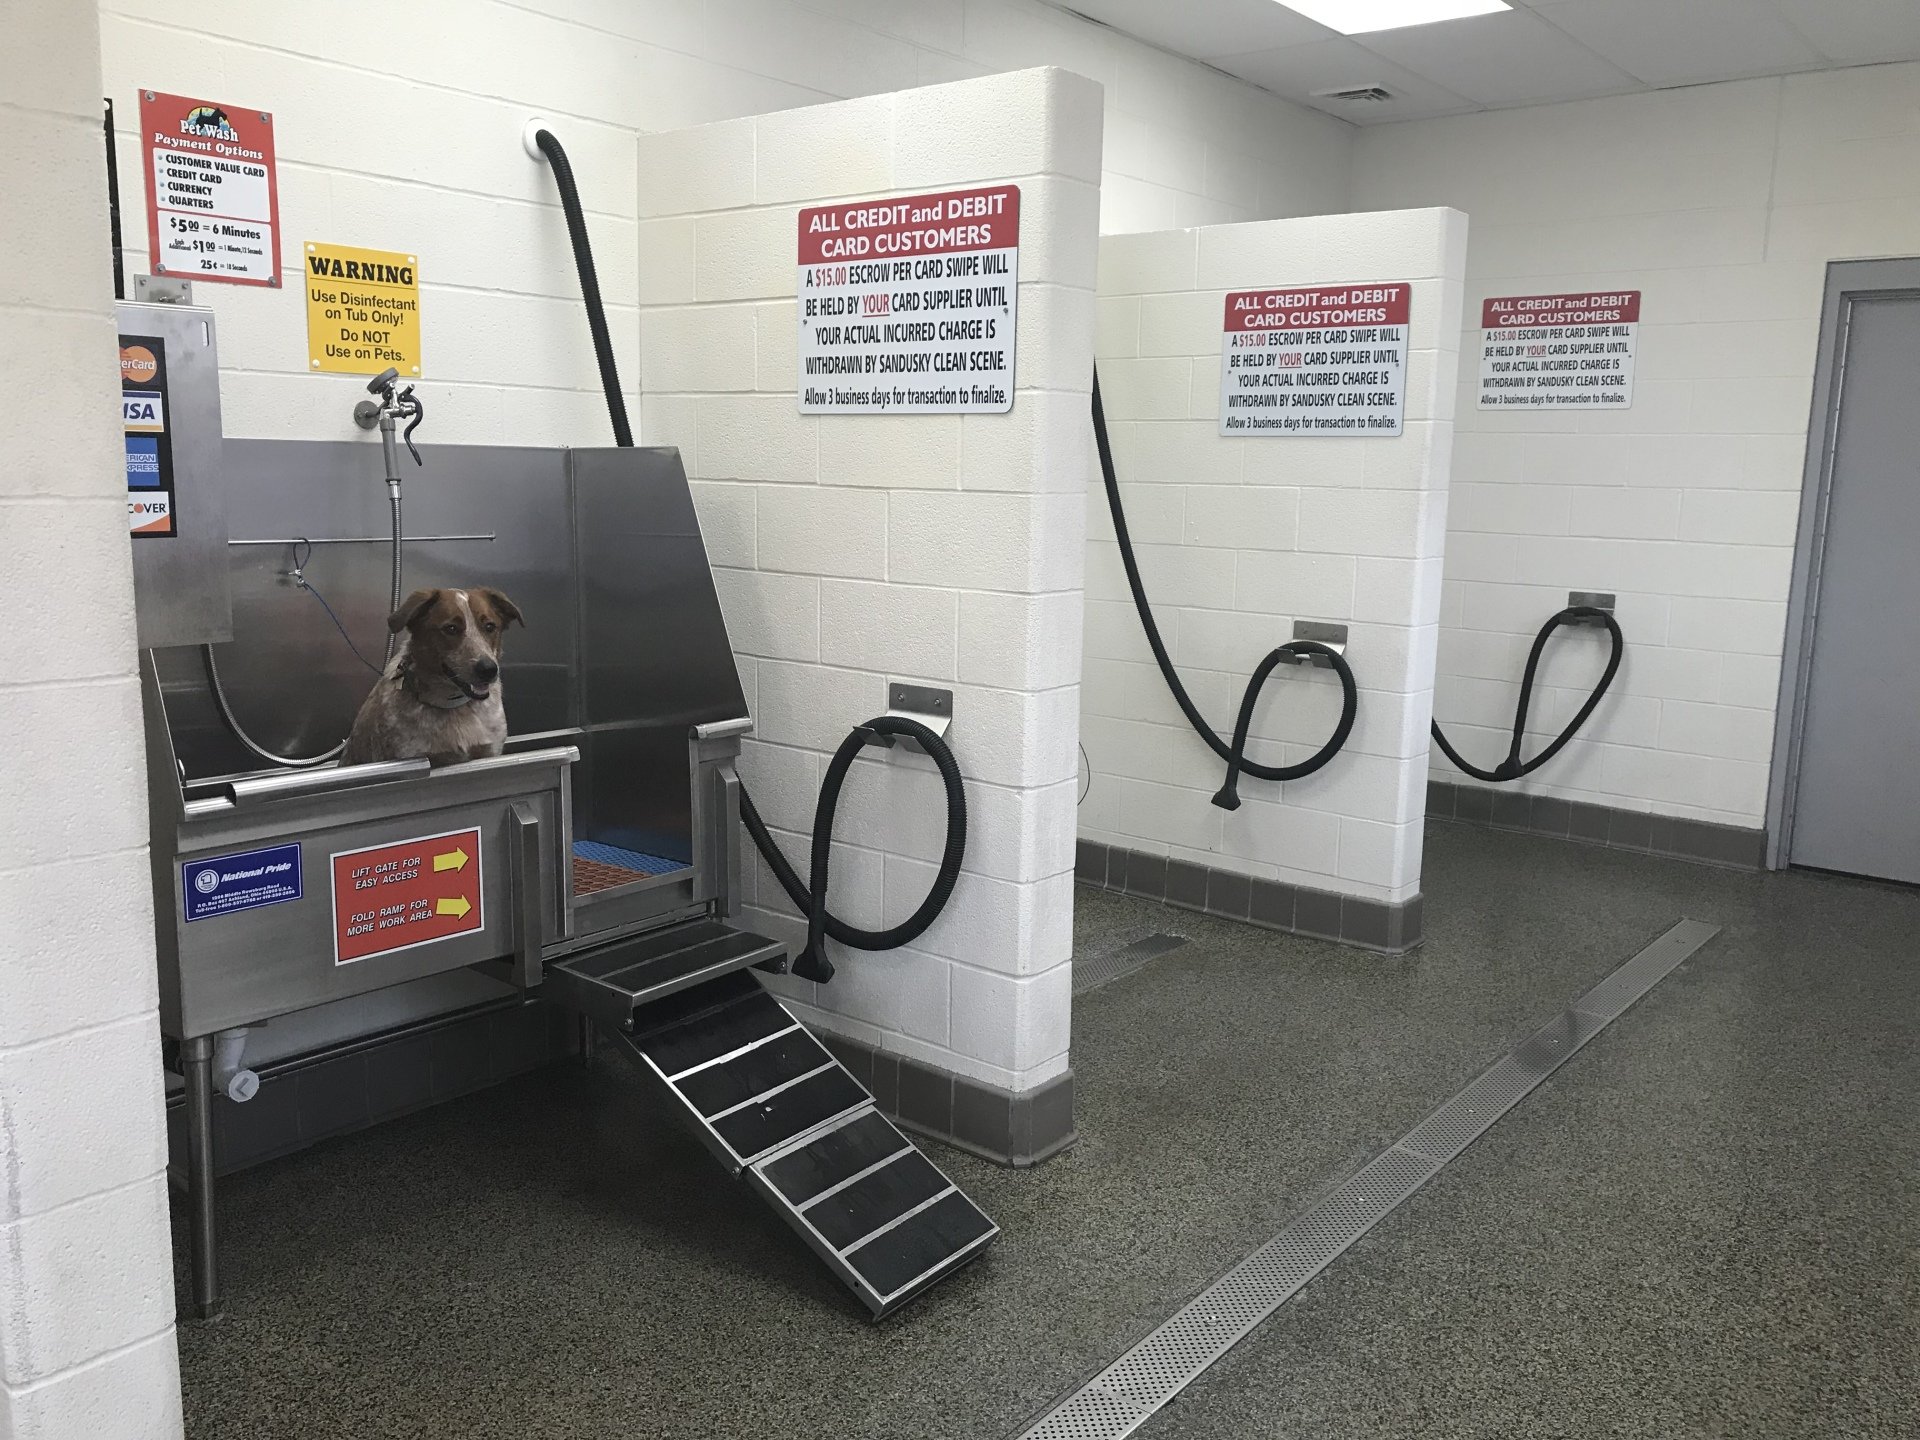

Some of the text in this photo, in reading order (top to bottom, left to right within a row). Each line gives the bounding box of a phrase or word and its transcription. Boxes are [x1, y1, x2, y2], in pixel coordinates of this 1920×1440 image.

[180, 120, 239, 143] Pet Wash
[155, 133, 263, 160] Payment Options
[166, 154, 264, 178] CUSTOMER VALUE CARD
[167, 168, 222, 184] CREDIT CARD
[168, 181, 212, 196] CURRENCY
[169, 195, 214, 209] QUARTERS
[809, 194, 1007, 233] ALL CREDIT and DEBIT
[213, 224, 219, 234] 6
[222, 225, 260, 239] Minutes
[821, 224, 991, 257] CARD CUSTOMERS
[309, 256, 412, 285] WARNING
[806, 254, 1008, 288] A $15.00 ESCROW PER CARD SWIPE WILL
[312, 289, 416, 310] Use Disinfectant
[806, 286, 1008, 316] BE HELD BY YOUR CARD SUPPLIER UNTIL
[1235, 288, 1399, 310] ALL CREDIT and DEBIT
[1491, 295, 1631, 312] ALL CREDIT and DEBIT
[326, 308, 404, 327] on Tub Only!
[1244, 308, 1387, 327] CARD CUSTOMERS
[1499, 310, 1620, 325] CARD CUSTOMERS
[340, 328, 390, 344] Do NOT
[816, 319, 995, 345] YOUR ACTUAL INCURRED CHARGE IS
[1232, 328, 1400, 347] A $15.00 ESCROW PER CARD SWIPE WILL
[1486, 326, 1629, 341] A $15.00 ESCROW PER CARD SWIPE WILL
[326, 344, 405, 361] Use on Pets.
[1231, 349, 1399, 367] BE HELD BY YOUR CARD SUPPLIER UNTIL
[1485, 343, 1628, 357] BE HELD BY YOUR CARD SUPPLIER UNTIL
[121, 358, 155, 370] erCard
[806, 351, 1006, 374] WITHDRAWN BY SANDUSKY CLEAN SCENE.
[1492, 359, 1620, 372] YOUR ACTUAL INCURRED CHARGE IS
[1239, 371, 1389, 387] YOUR ACTUAL INCURRED CHARGE IS
[1483, 375, 1626, 388] WITHDRAWN BY SANDUSKY CLEAN SCENE.
[804, 385, 1006, 408] Allow 3 business days for transaction to finalize.
[1228, 392, 1397, 407] WITHDRAWN BY SANDUSKY CLEAN SCENE.
[123, 403, 155, 419] ISA
[1226, 415, 1396, 431] Allow 3 business days for transaction to finalize.
[128, 503, 165, 513] COVER
[221, 863, 292, 883] National Pride
[351, 857, 421, 879] LIFT GATE FOR
[355, 869, 418, 890] EASY ACCESS
[350, 899, 428, 924] FOLD RAMP FOR
[347, 909, 432, 937] MORE WORK AREA
